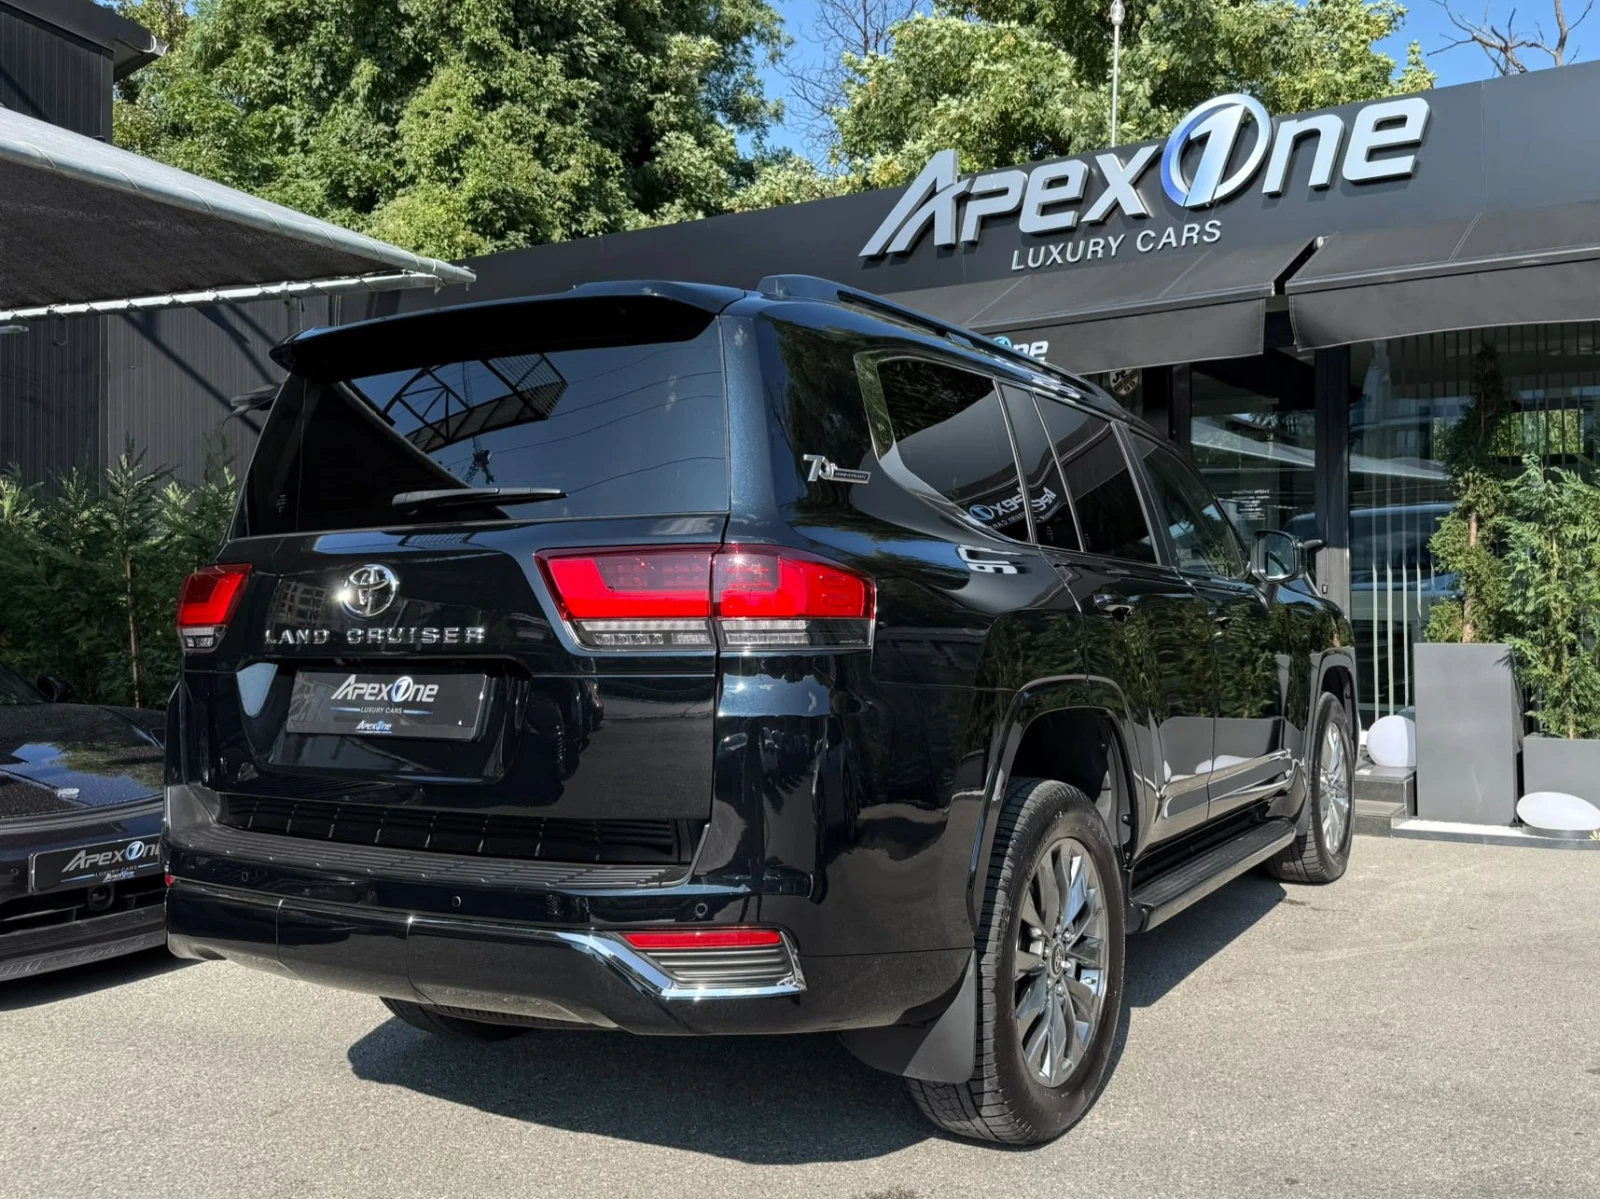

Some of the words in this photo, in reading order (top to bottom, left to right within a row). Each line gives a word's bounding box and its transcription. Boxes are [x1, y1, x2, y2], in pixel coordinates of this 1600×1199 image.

[1010, 233, 1126, 271] LUXURY
[1135, 220, 1223, 253] CARS
[264, 629, 330, 645] LAND
[347, 626, 485, 644] CRUISER
[360, 707, 384, 715] LUXURY
[385, 707, 403, 715] CARS
